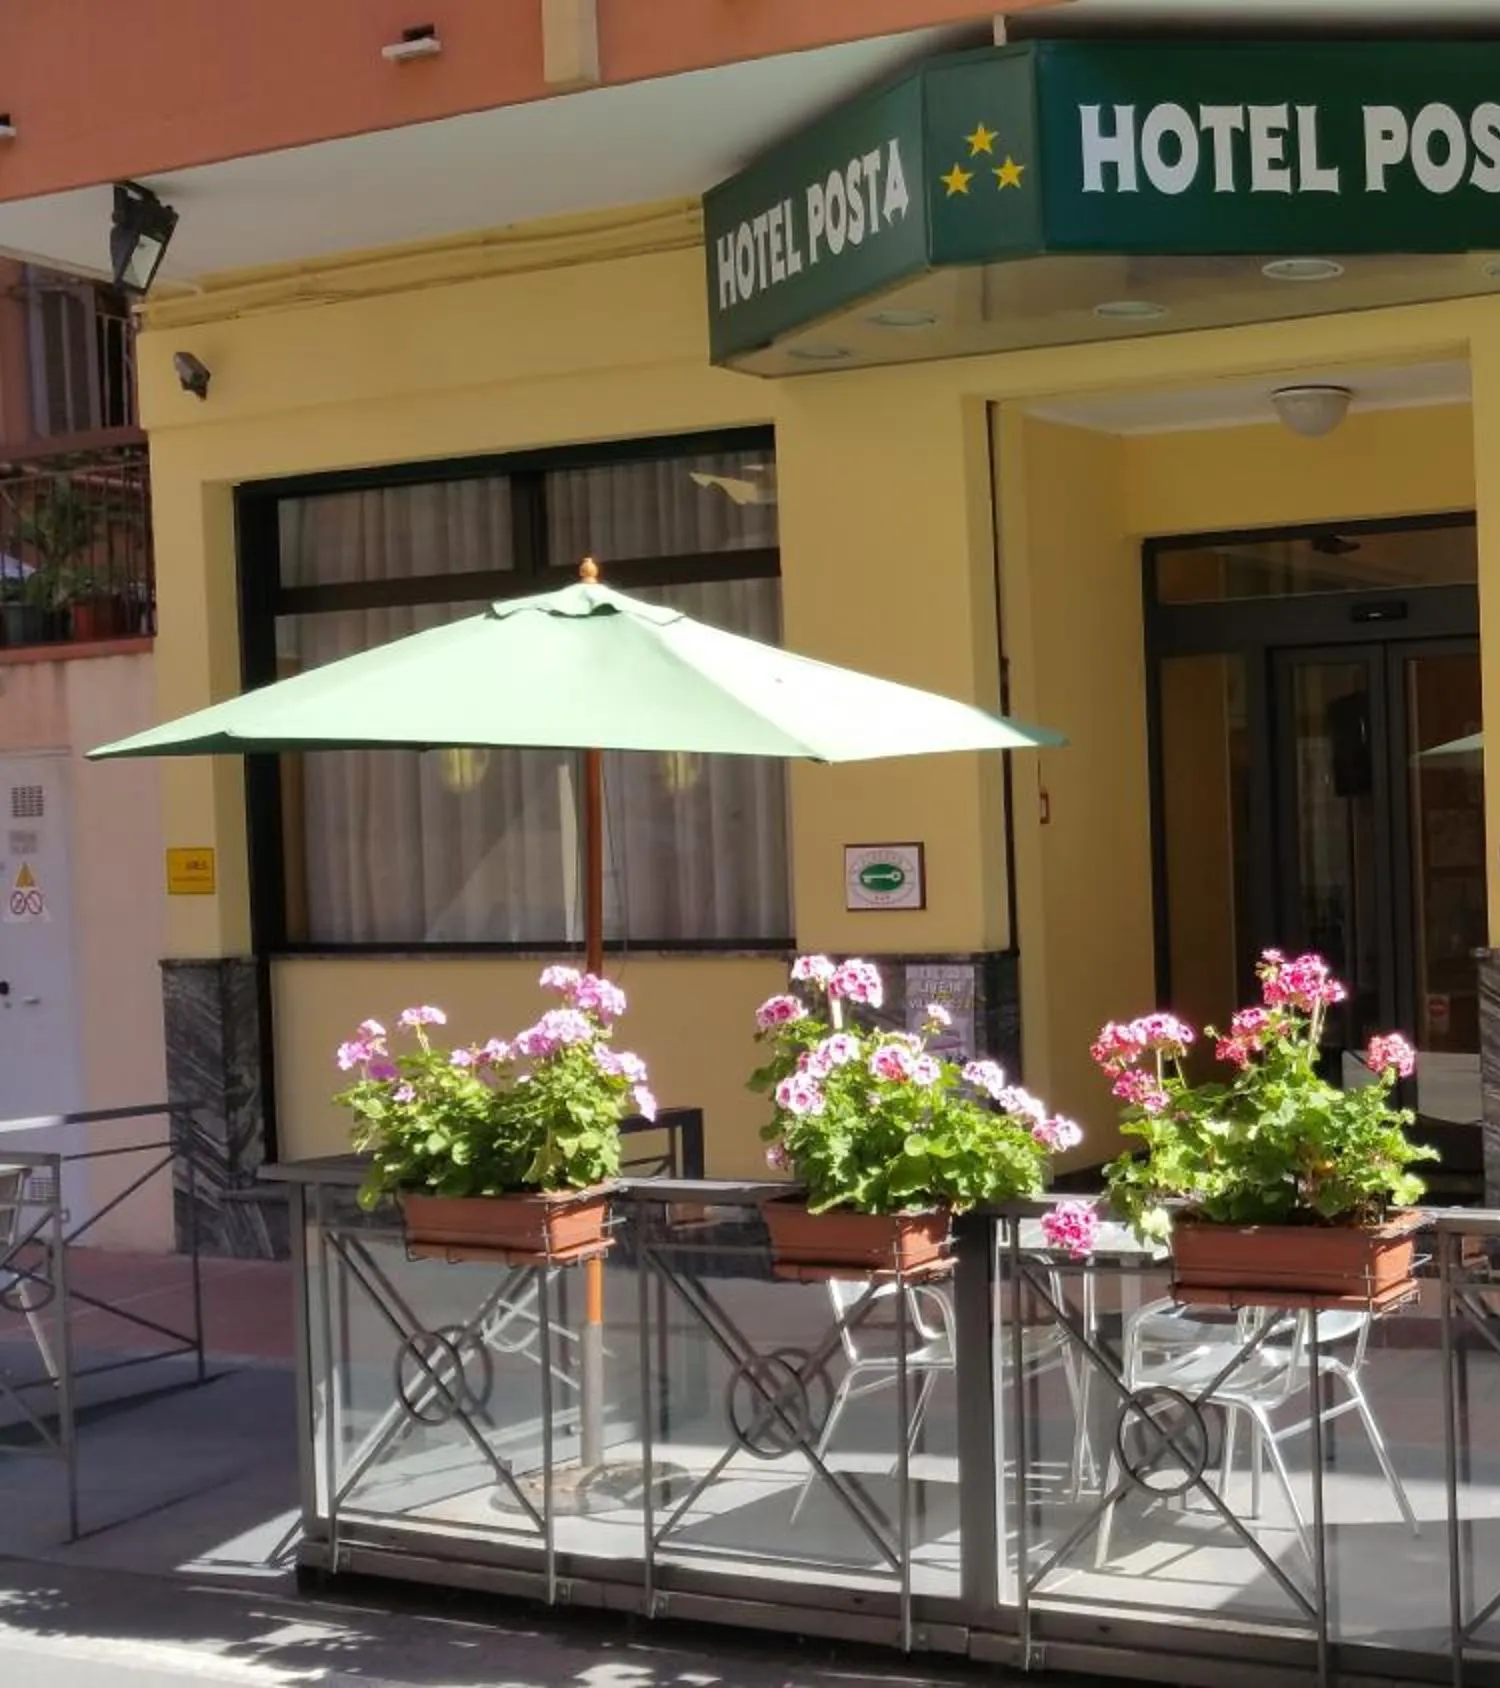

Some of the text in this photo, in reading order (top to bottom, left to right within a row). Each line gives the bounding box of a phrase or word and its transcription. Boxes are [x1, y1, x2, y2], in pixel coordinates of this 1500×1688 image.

[1079, 103, 1339, 194] HOTEL
[717, 137, 911, 309] HOTEL POSTA
